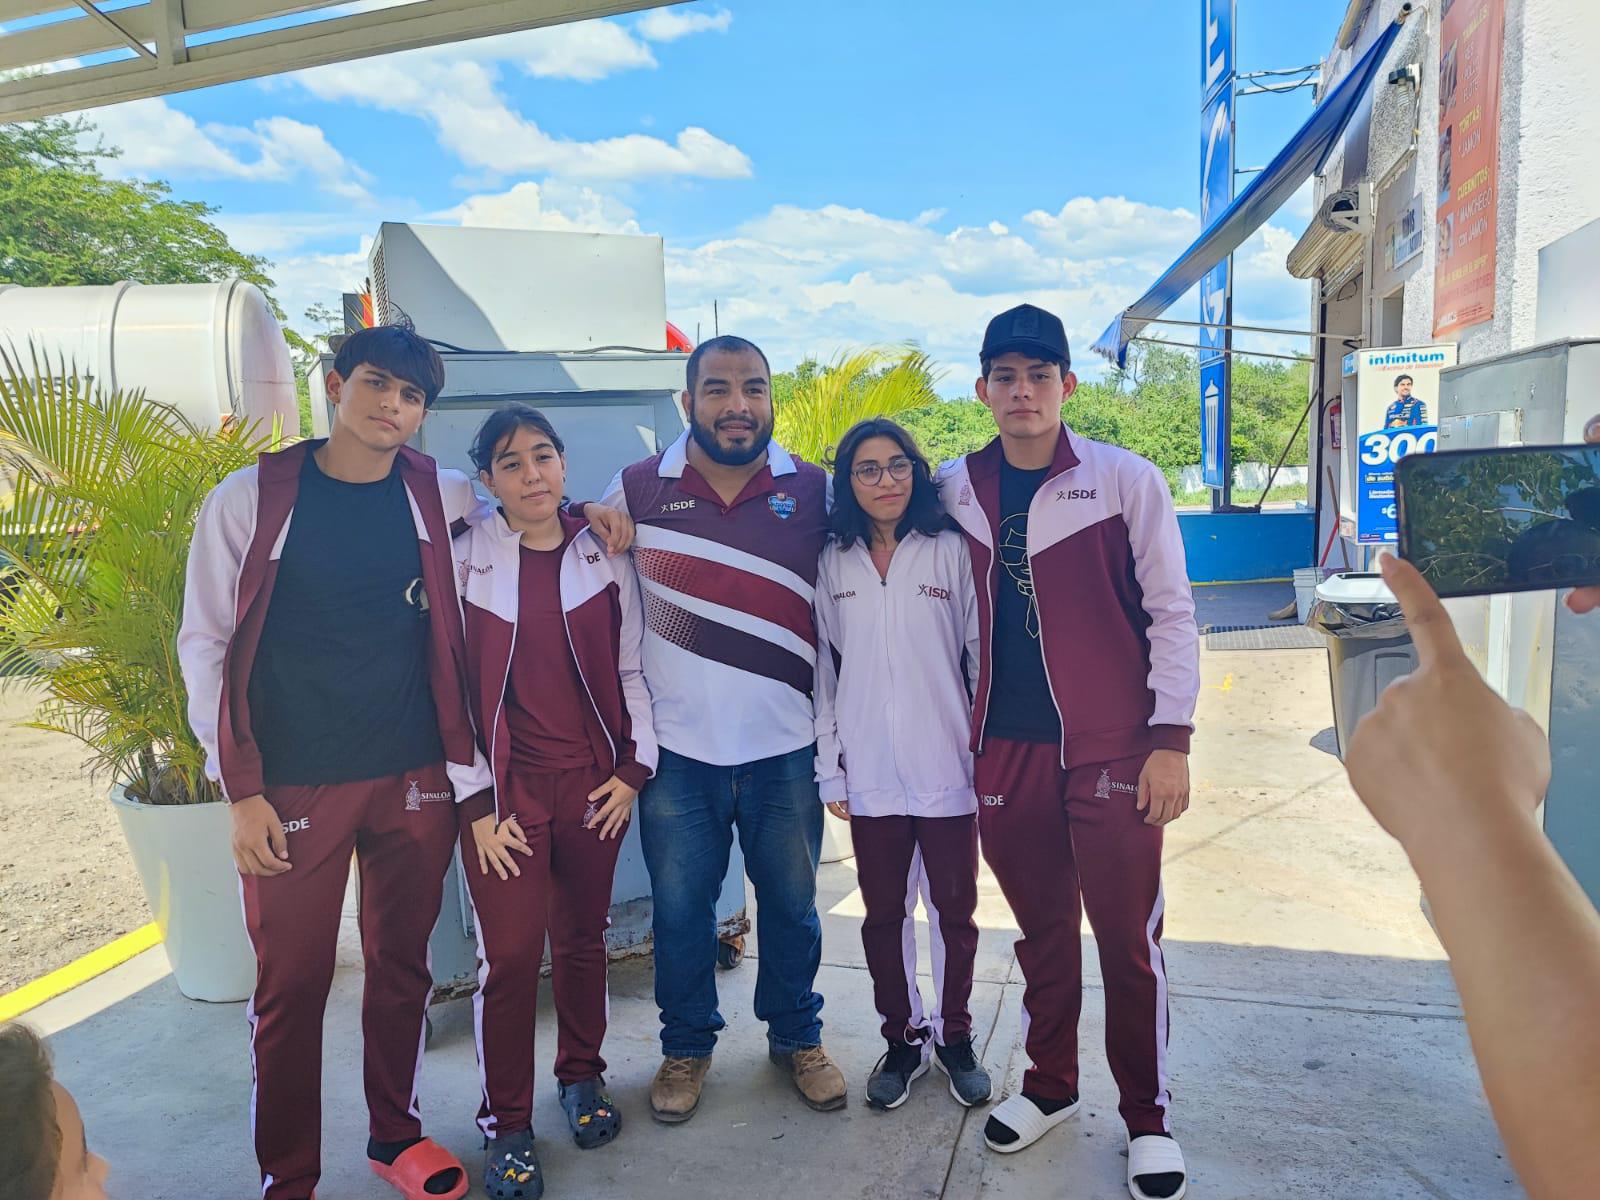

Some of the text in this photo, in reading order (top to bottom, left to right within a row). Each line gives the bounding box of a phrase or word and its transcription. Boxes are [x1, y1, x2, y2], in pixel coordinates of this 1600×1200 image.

[1369, 352, 1445, 365] infinitum
[1067, 488, 1097, 500] ISDE
[670, 499, 696, 511] ISDE
[421, 791, 451, 800] SINALOA
[281, 816, 311, 834] SDE
